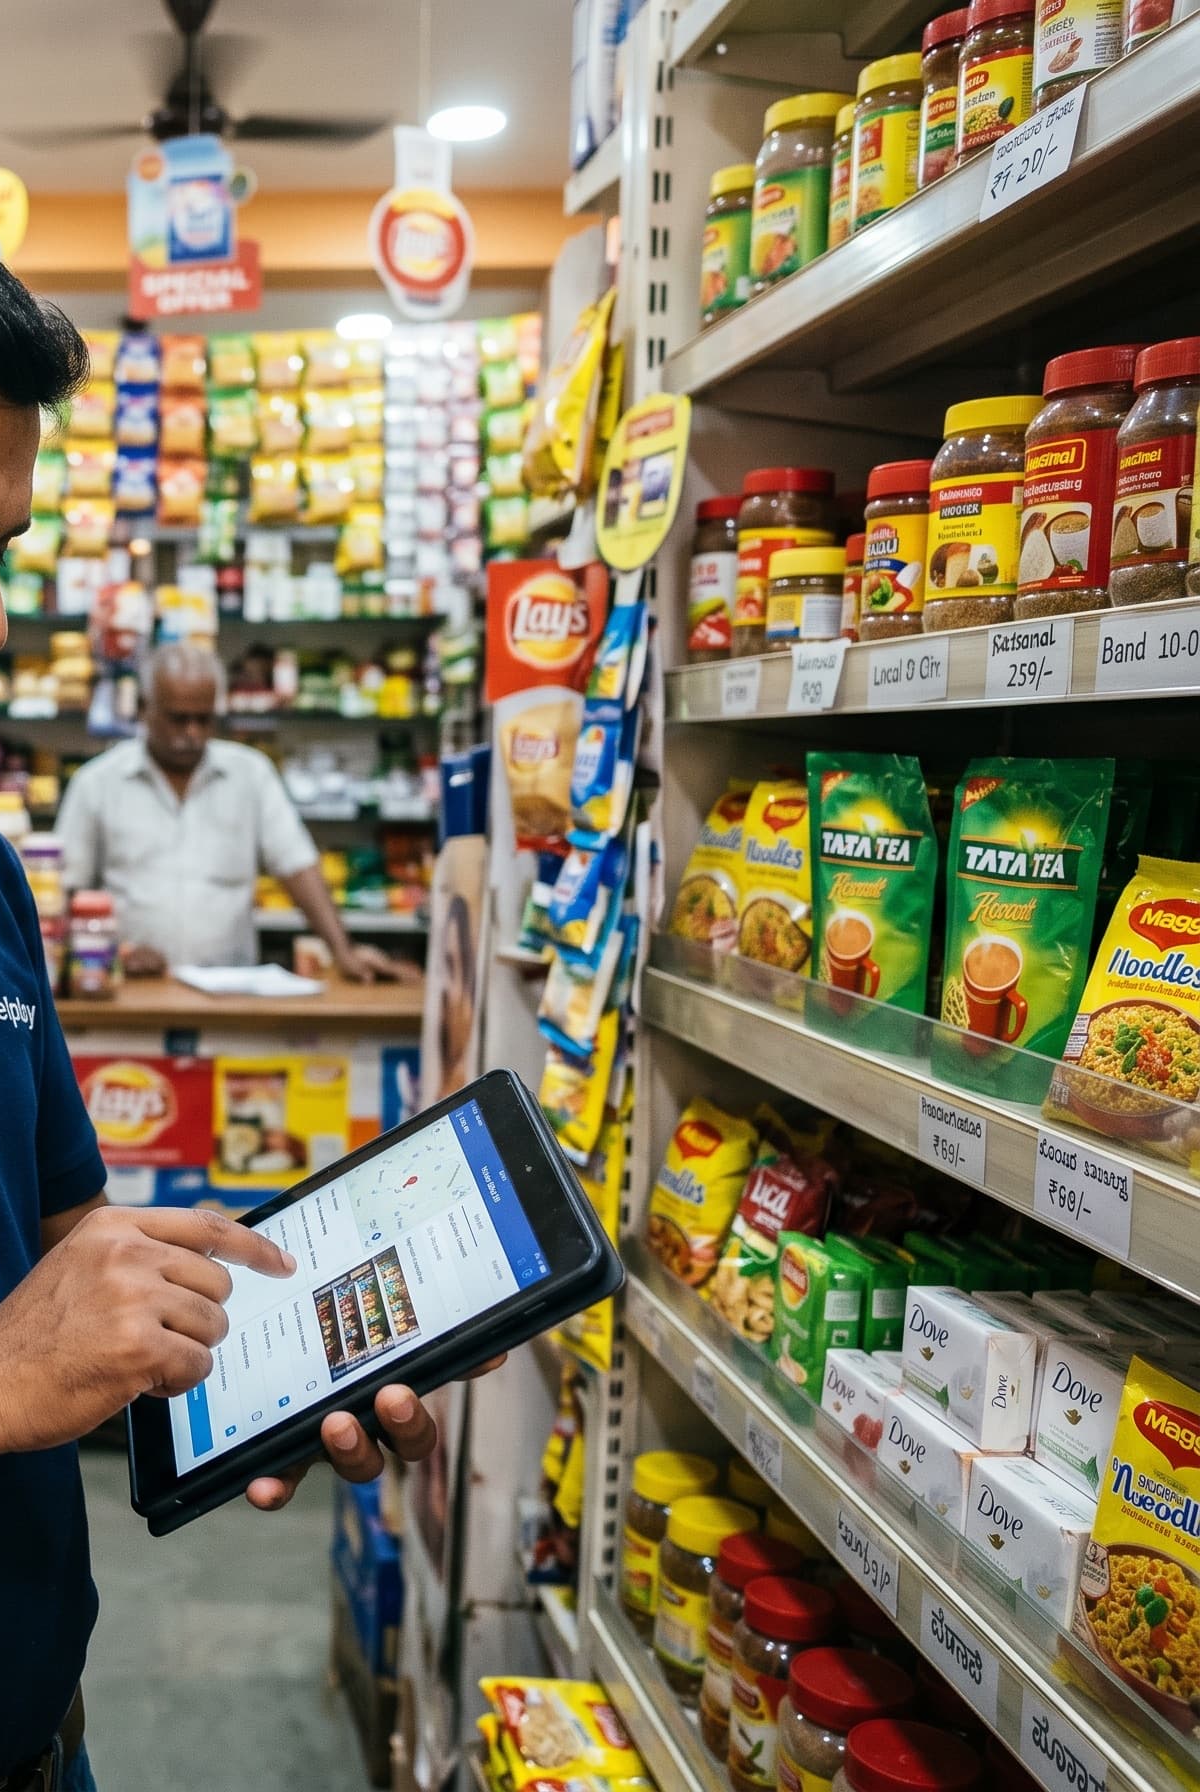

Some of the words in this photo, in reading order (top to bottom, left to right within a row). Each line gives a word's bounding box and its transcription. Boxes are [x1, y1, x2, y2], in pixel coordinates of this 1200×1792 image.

[1101, 631, 1147, 665] Band
[1007, 656, 1053, 691] 259/-
[822, 831, 872, 859] TATA
[875, 835, 910, 862] TEA
[966, 845, 1027, 876] TATA
[1032, 852, 1065, 879] TEA
[909, 1304, 949, 1348] Dove
[826, 1365, 856, 1405] Dove
[992, 1374, 1009, 1408] Dove
[1052, 1361, 1103, 1413] Dove
[888, 1416, 926, 1463] Dove
[977, 1484, 1024, 1540] Dove
